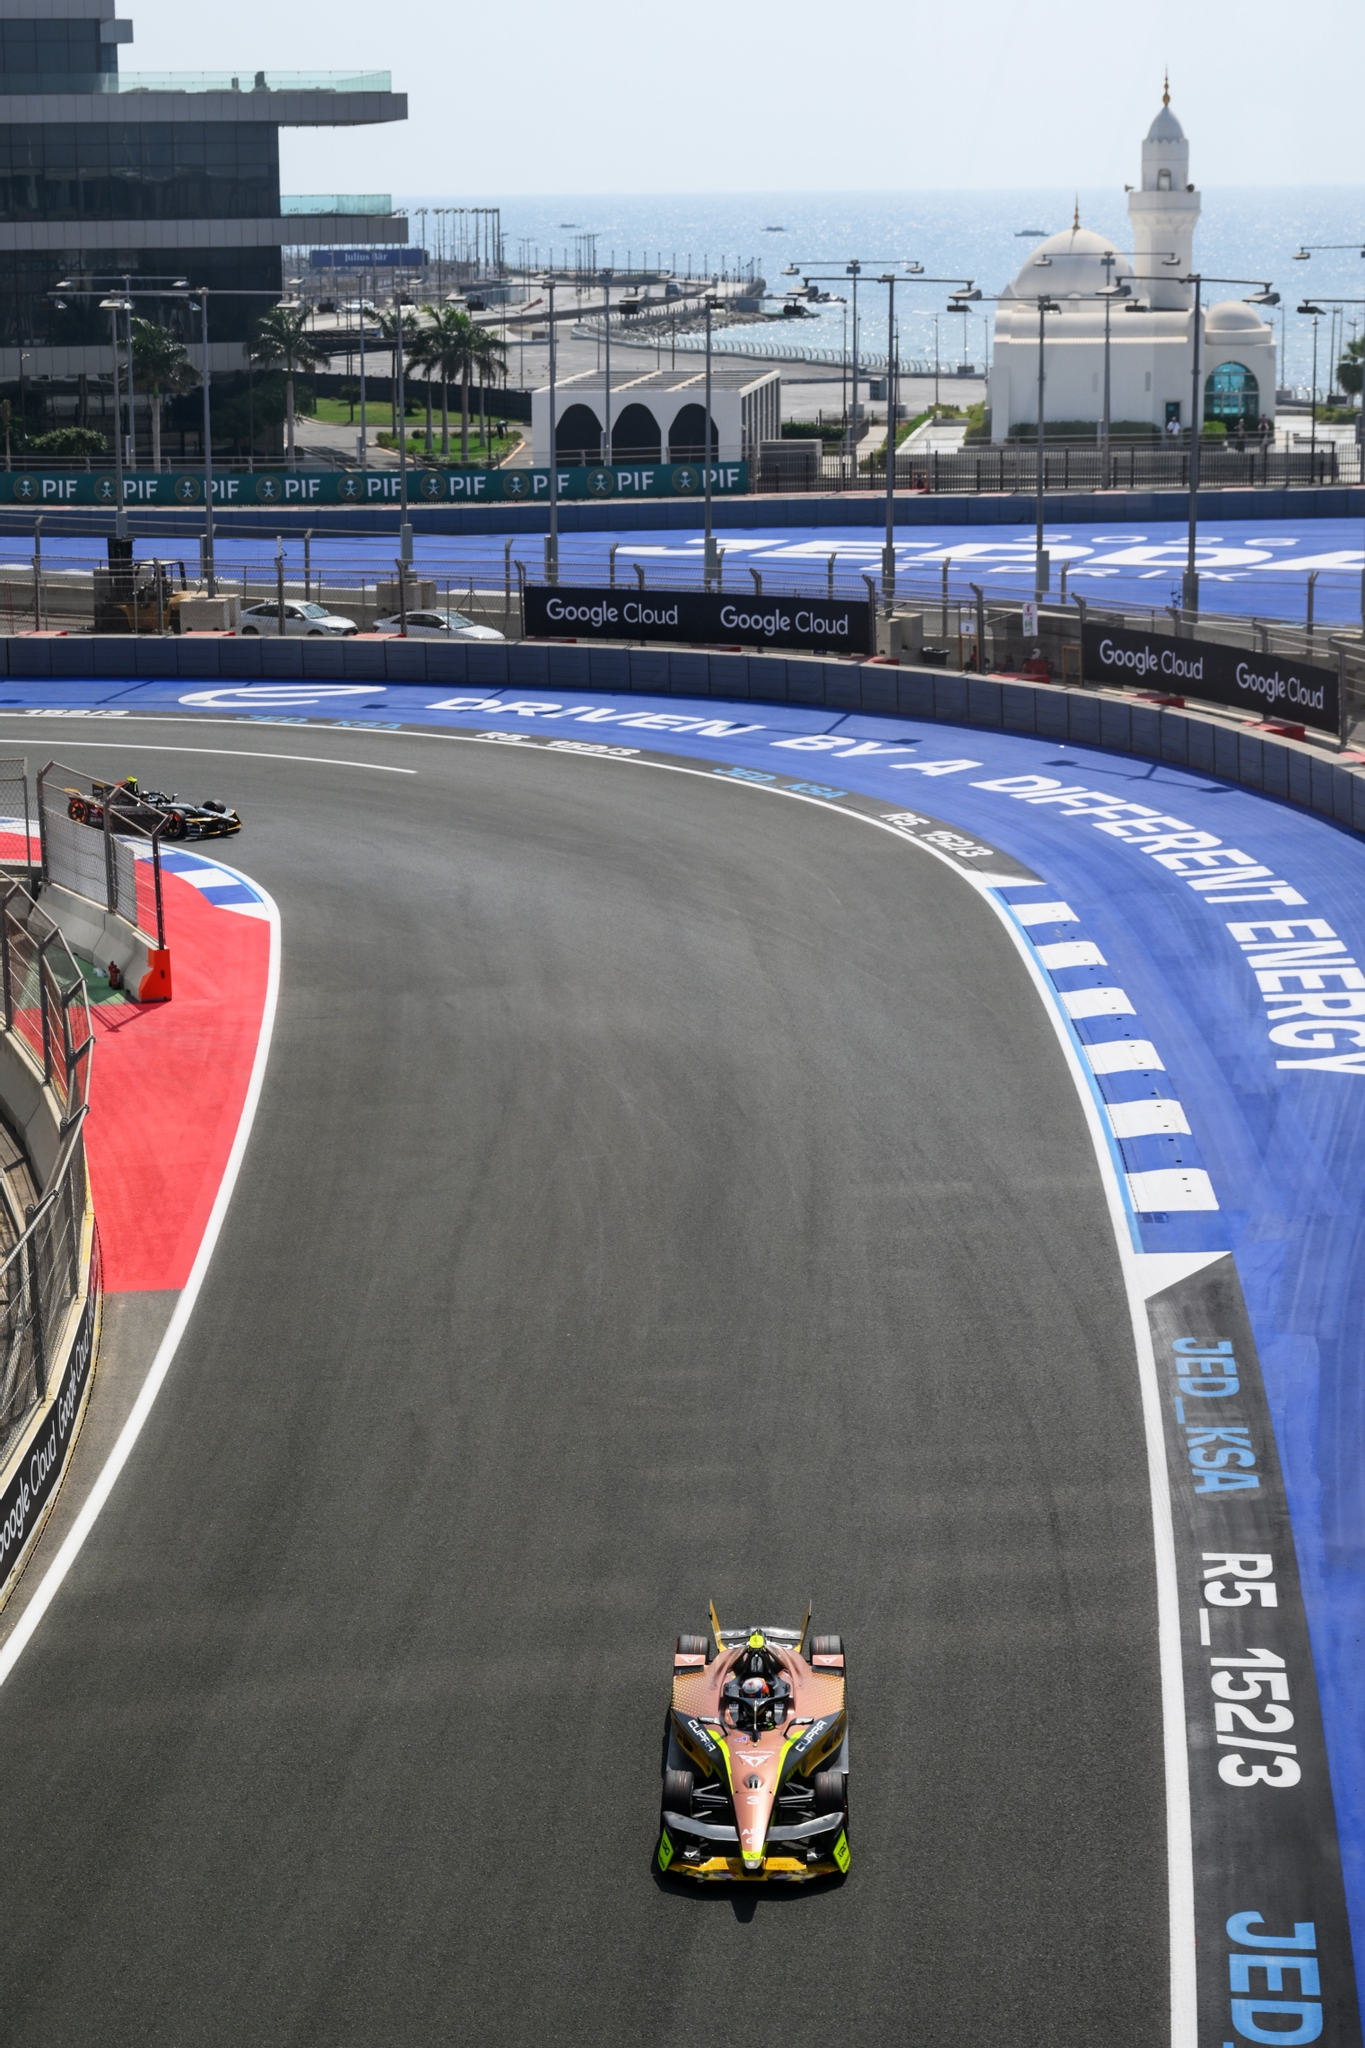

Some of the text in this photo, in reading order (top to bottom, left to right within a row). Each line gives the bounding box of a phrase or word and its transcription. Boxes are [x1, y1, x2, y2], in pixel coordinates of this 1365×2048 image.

[345, 252, 370, 262] Julius
[42, 480, 78, 498] PIF
[123, 480, 158, 499] PIF
[204, 480, 240, 499] PIF
[285, 479, 321, 498] PIF
[367, 478, 401, 497] PIF
[450, 476, 486, 495] PIF
[533, 474, 570, 494] PF
[617, 471, 654, 491] PIF
[702, 468, 740, 488] PIF
[546, 598, 678, 627] Google Cloud
[720, 605, 849, 636] Google Cloud
[1100, 639, 1203, 680] Google Cloud
[1236, 662, 1324, 710] Google Cloud
[424, 697, 1365, 1075] DRIVEN BY A DIFFERENT ENERGY
[59, 1363, 77, 1440] Google
[1172, 1337, 1260, 1494] JED_KSA
[30, 1420, 57, 1496] Cloud
[1200, 1552, 1301, 1788] R5_152/3
[687, 1719, 717, 1752] CUPRA
[795, 1720, 828, 1752] CUPRA
[746, 1795, 759, 1804] 3
[1223, 1910, 1324, 2048] JED
